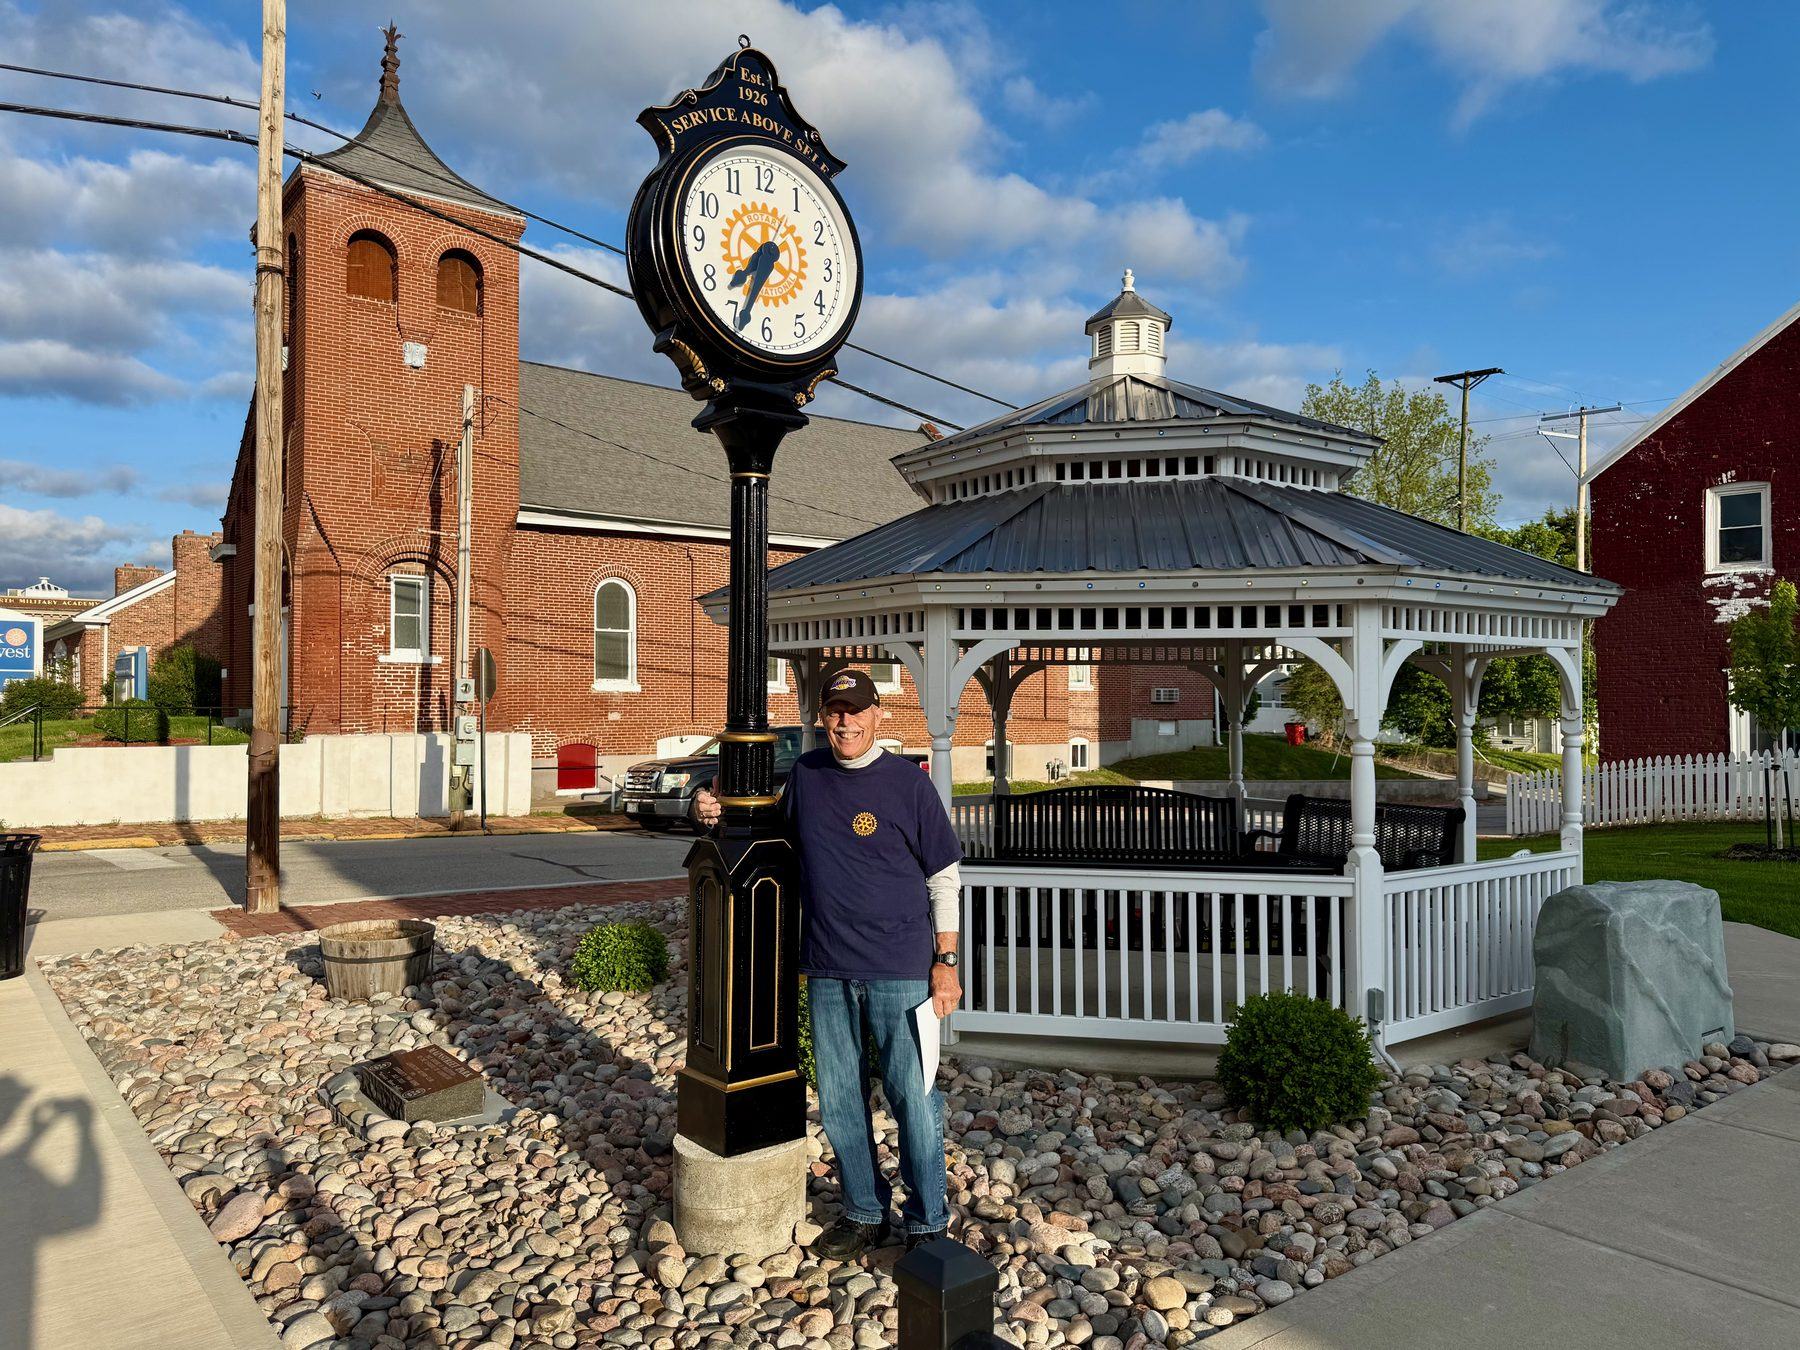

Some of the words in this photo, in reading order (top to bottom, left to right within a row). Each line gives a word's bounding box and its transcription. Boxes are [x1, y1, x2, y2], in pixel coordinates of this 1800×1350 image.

[740, 66, 765, 87] Est.
[738, 86, 768, 107] 1926
[671, 107, 738, 135] SERVICE
[741, 110, 794, 144] ABOVE
[795, 138, 830, 174] SELF
[726, 168, 742, 196] 11
[755, 166, 775, 194] 12
[699, 191, 719, 219] 10
[793, 188, 800, 213] 1
[693, 225, 705, 252] 9
[813, 221, 826, 246] 2
[703, 264, 716, 291] 8
[823, 258, 832, 282] 3
[725, 300, 738, 327] 7
[814, 290, 826, 315] 4
[761, 317, 772, 342] 6
[793, 313, 806, 338] 5
